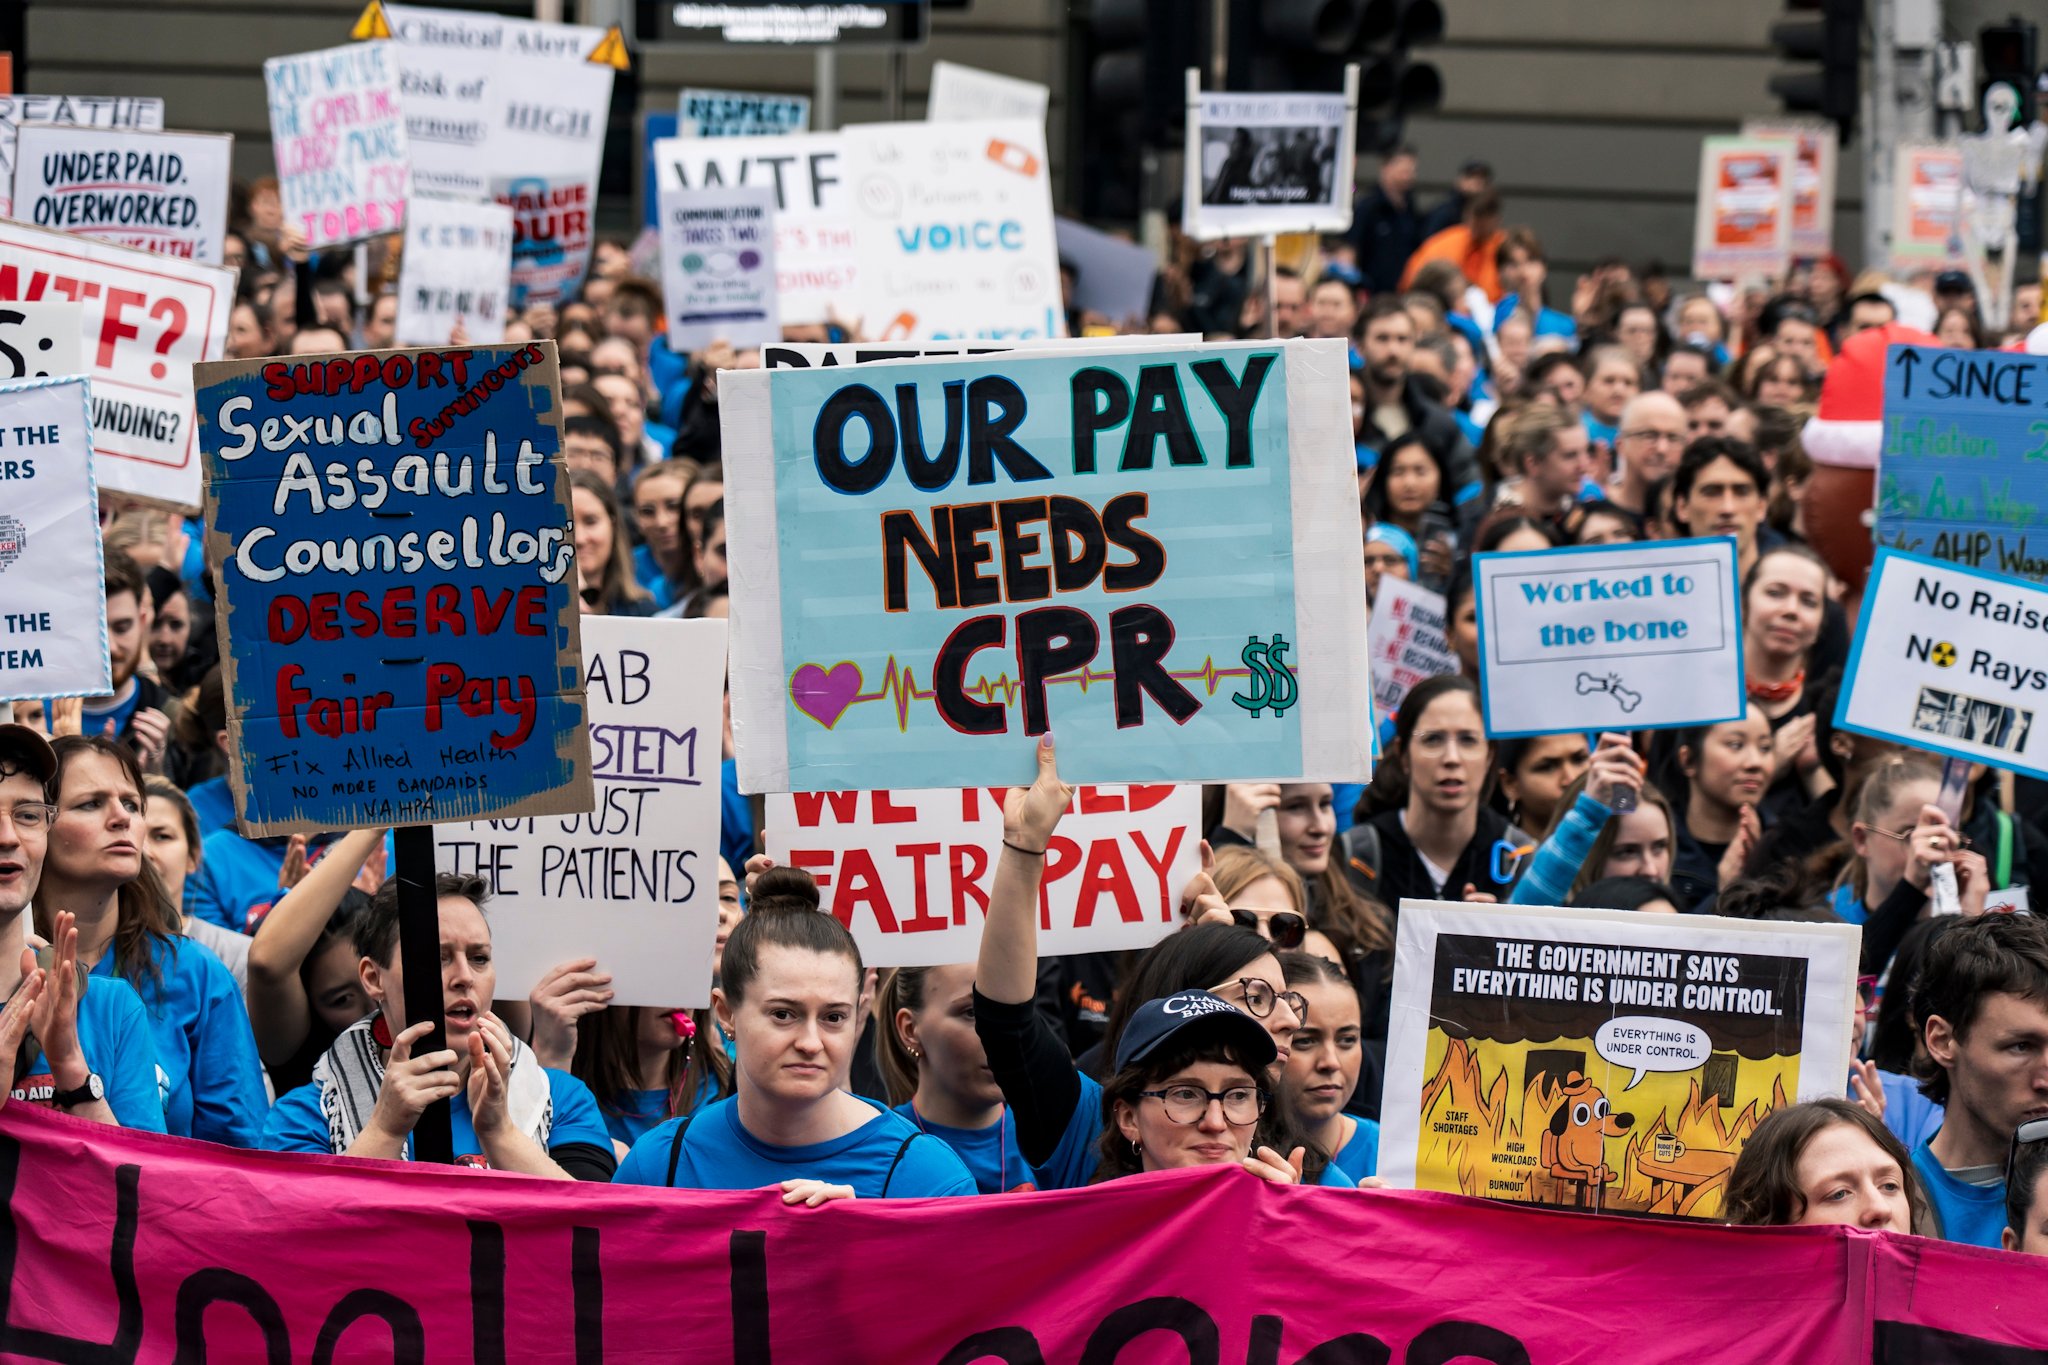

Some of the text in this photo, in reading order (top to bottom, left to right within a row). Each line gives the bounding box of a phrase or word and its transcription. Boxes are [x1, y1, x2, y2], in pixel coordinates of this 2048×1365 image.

[400, 20, 580, 56] Clinical Alert
[506, 100, 592, 138] HIGH
[33, 193, 201, 229] OVERWORKED.
[897, 221, 1023, 253] VOICE
[262, 350, 473, 402] SUPPORT
[1928, 353, 2037, 405] SINCE
[13, 425, 60, 447] THE
[216, 391, 405, 462] Sexual
[813, 353, 1280, 495] OUR PAY
[272, 430, 546, 516] Assault
[880, 491, 1168, 612] NEEDS
[1520, 573, 1695, 605] Worked to
[1914, 578, 1960, 610] No
[4, 612, 51, 634] THE
[268, 584, 548, 645] DESERVE
[1540, 619, 1689, 647] the bone
[933, 603, 1202, 736] CPR
[1970, 649, 2047, 692] Rays
[424, 663, 537, 751] Pay
[265, 742, 517, 776] Fix Allied Health
[592, 723, 698, 778] STEM
[292, 785, 319, 800] NO
[332, 780, 376, 796] MORE
[541, 844, 698, 904] PATIENTS
[1039, 826, 1188, 931] PAY
[1495, 942, 1740, 984] THE GOVERNMENT SAYS
[1452, 968, 1783, 1017] EVERYTHING IS UNDER CONTROL.
[1606, 1042, 1701, 1060] UNDER CONTROL.
[1613, 1027, 1697, 1045] EVERYTHING IS
[1433, 1121, 1479, 1137] SHORTAGES
[1445, 1110, 1469, 1123] STAFF
[1491, 1152, 1538, 1168] WORKLOADS
[1506, 1141, 1525, 1154] HIGH
[1657, 1143, 1674, 1151] BUDGET
[1489, 1179, 1524, 1193] BURNOUT
